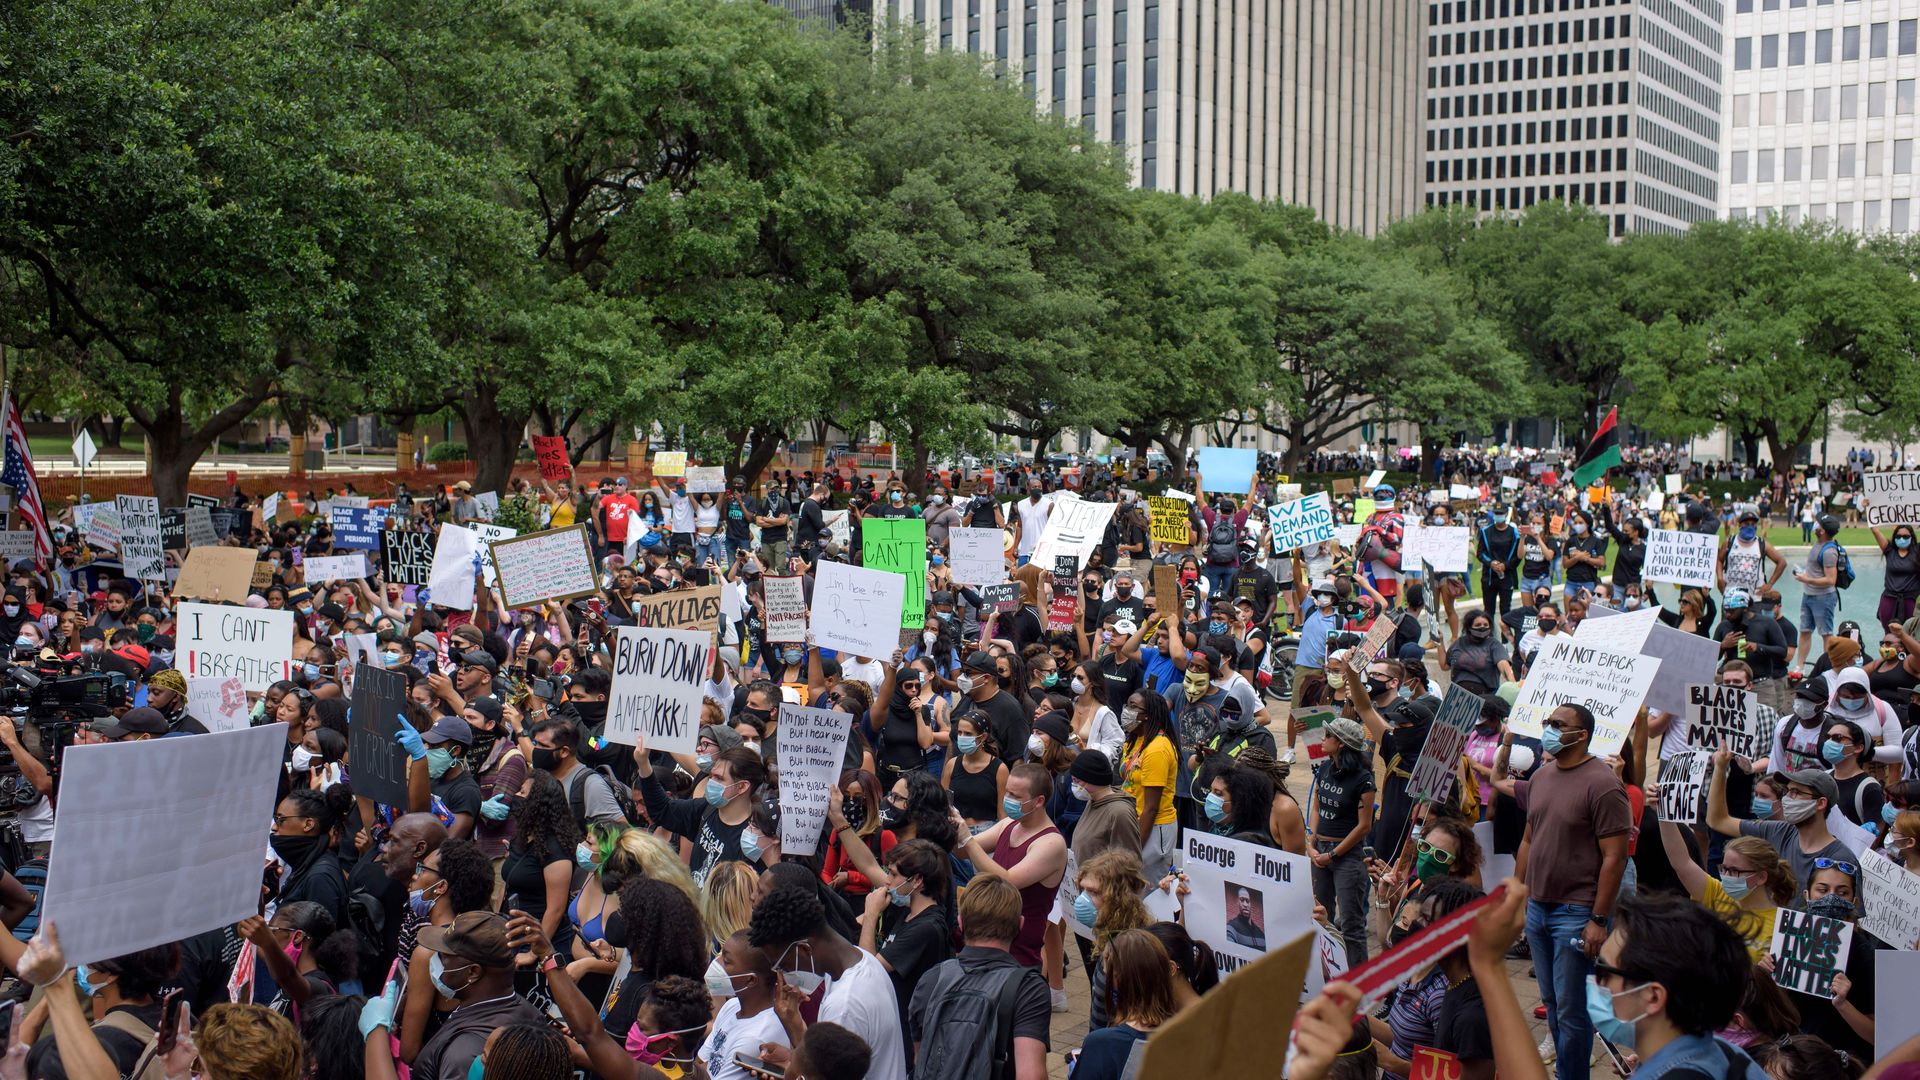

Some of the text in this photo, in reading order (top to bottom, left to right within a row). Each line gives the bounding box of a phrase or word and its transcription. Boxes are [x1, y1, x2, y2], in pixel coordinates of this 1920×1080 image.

[119, 496, 154, 513] POLICE
[1149, 497, 1171, 509] GEORGE
[1269, 495, 1321, 518] WE
[486, 527, 501, 537] NO
[881, 519, 901, 540] I
[1165, 517, 1184, 529] NEEDS
[1272, 509, 1329, 535] DEMAND
[385, 531, 431, 551] BLACK
[1153, 525, 1187, 541] JUSTICE!
[1274, 523, 1335, 552] JUSTICE
[1652, 531, 1708, 546] WHO DO I
[388, 547, 433, 566] LIVES
[864, 541, 920, 571] CAN'T
[1653, 544, 1713, 558] CALL THE
[1646, 566, 1674, 576] WEARS
[1676, 569, 1681, 577] A
[1652, 555, 1710, 568] MURDERER
[826, 571, 844, 590] I'm
[849, 574, 867, 595] here
[873, 580, 888, 597] for
[985, 585, 1013, 595] When
[639, 596, 721, 627] BLACK LIVES
[191, 612, 271, 642] I CANT
[616, 636, 708, 687] BURN DOWN
[1551, 643, 1570, 662] IM
[1569, 646, 1597, 664] NOT
[355, 664, 396, 700] BLACK IS
[1608, 669, 1631, 684] hear
[1530, 689, 1547, 706] IM
[1596, 679, 1618, 693] with
[1620, 687, 1640, 704] you
[1690, 686, 1747, 712] BLACK
[780, 707, 793, 726] I'm
[793, 714, 809, 726] not
[1515, 706, 1533, 723] But
[1700, 706, 1747, 731] LIVES
[810, 728, 830, 739] hear
[832, 733, 846, 743] you
[1421, 721, 1458, 764] SHOULD
[1687, 724, 1754, 758] MATTER
[779, 742, 789, 753] I'm
[790, 744, 803, 753] not
[365, 733, 398, 784] CRIME
[810, 759, 835, 768] mourn
[792, 781, 804, 789] not
[796, 771, 808, 780] you
[1407, 762, 1455, 802] ALIVE
[1319, 780, 1344, 795] GOOD
[782, 805, 793, 815] I'm
[795, 806, 807, 816] not
[1319, 808, 1337, 821] NLY
[1189, 838, 1291, 882] George Floyd
[1862, 852, 1895, 880] BLACK
[1883, 890, 1911, 914] COMES
[1779, 910, 1846, 945] BLACK
[1876, 901, 1910, 935] SILENCE
[1780, 934, 1839, 969] LIVES
